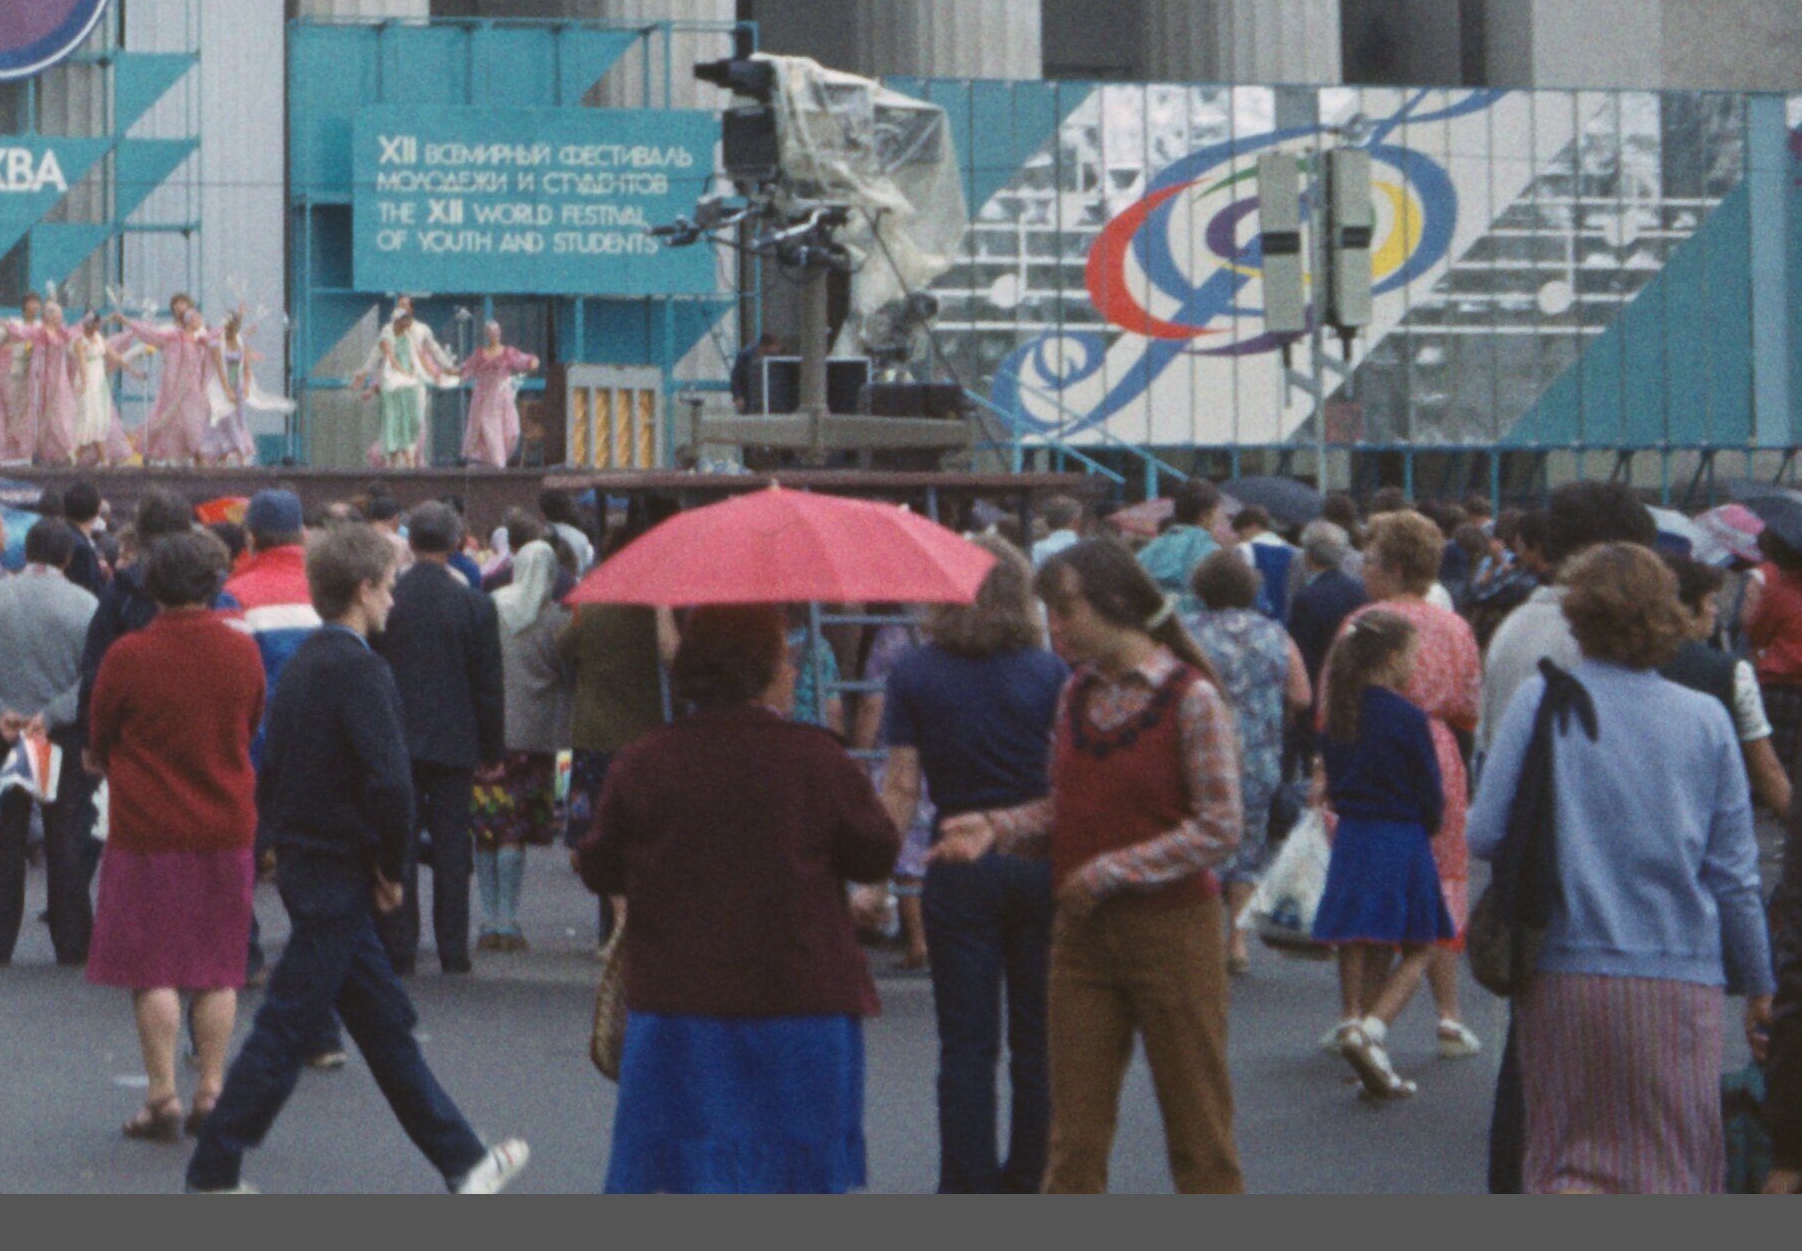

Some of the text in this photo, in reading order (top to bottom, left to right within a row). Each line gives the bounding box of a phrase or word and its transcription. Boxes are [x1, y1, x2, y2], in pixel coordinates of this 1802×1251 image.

[558, 144, 694, 169] ФЕСТИВАЛЬ
[517, 171, 535, 192] И
[378, 199, 646, 227] THE XII WORLD FESTIVAL
[376, 229, 659, 255] OF YOUTH AND STUDENTS
